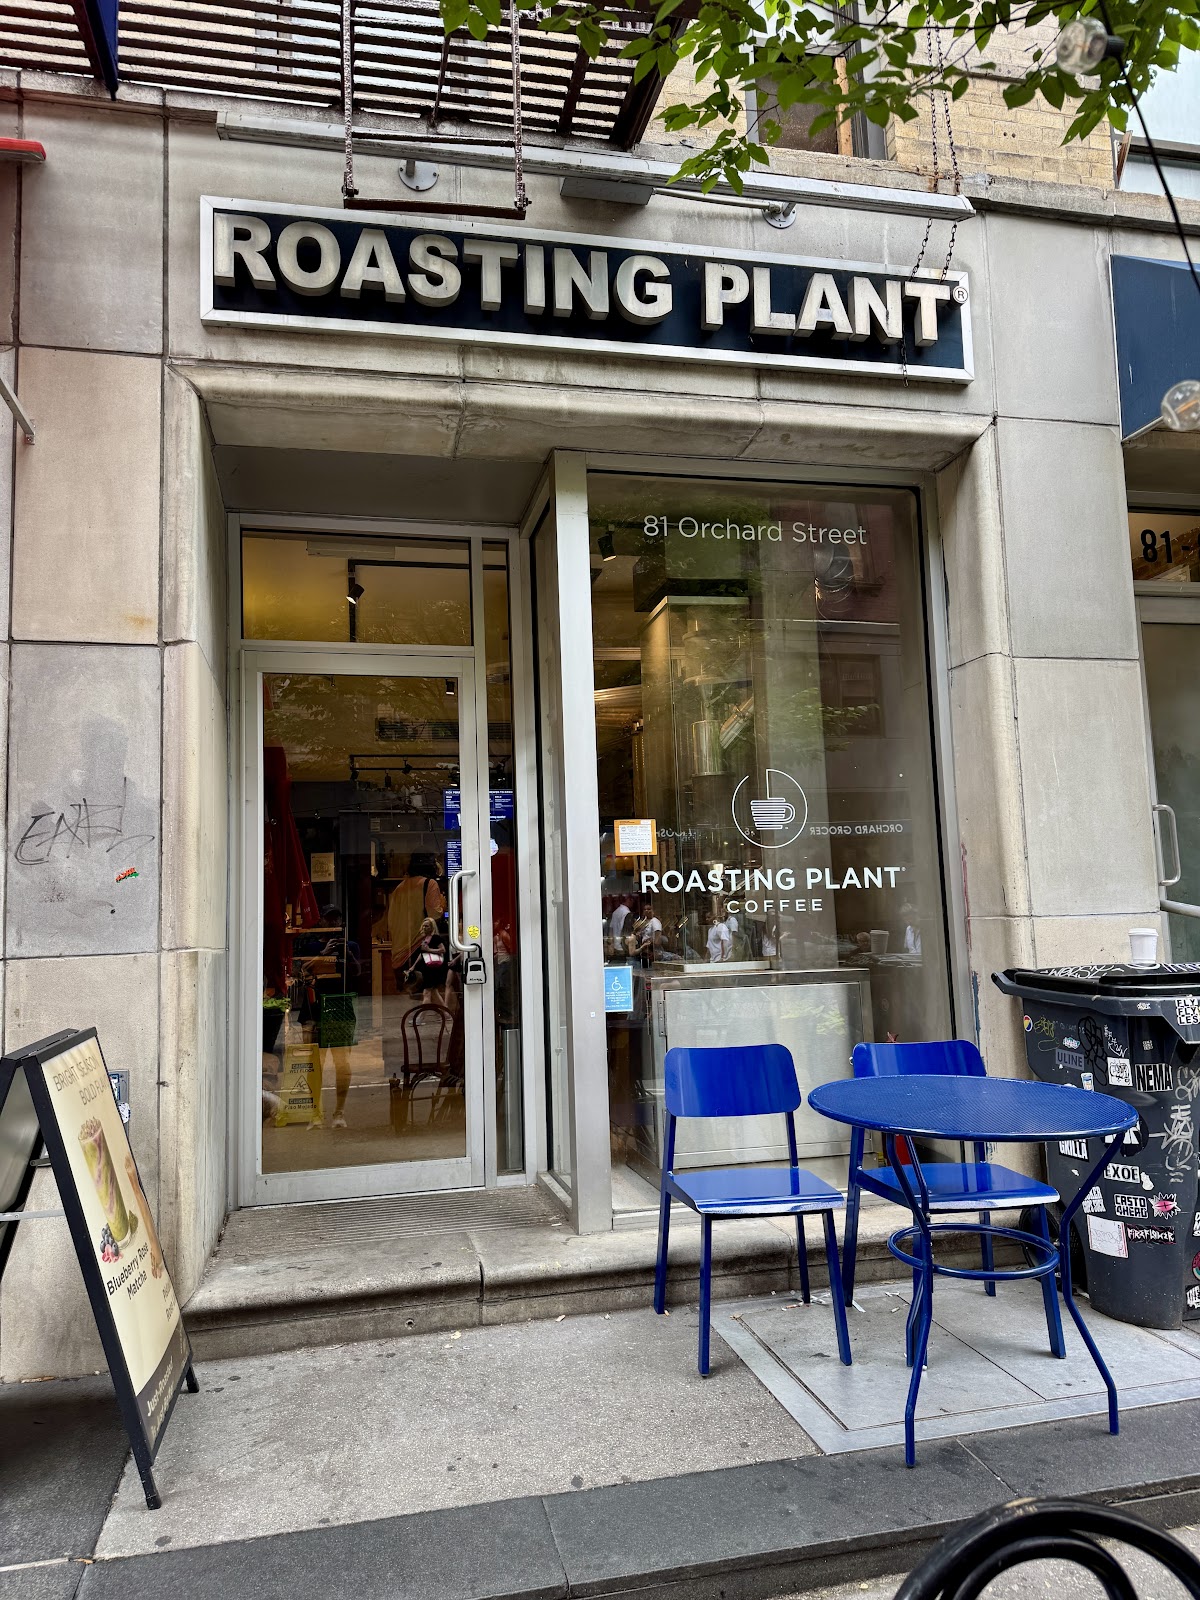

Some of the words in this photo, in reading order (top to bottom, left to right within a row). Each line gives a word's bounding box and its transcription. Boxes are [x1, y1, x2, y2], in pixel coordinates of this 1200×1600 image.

[213, 212, 673, 325] ROASTING
[643, 515, 668, 537] 81
[678, 516, 782, 542] Orchard
[792, 522, 867, 545] Street
[641, 868, 795, 894] ROASTING
[727, 898, 823, 914] COFFEE
[1176, 999, 1195, 1007] FLY
[1178, 1007, 1197, 1016] FLY
[1179, 1015, 1199, 1025] LES
[1057, 1051, 1083, 1068] ULINE
[53, 1065, 79, 1092] BRIGHT
[1136, 1064, 1172, 1091] NEMA
[79, 1083, 97, 1106] BOLD
[106, 1255, 140, 1296] Blueberry
[137, 1242, 149, 1262] Rose
[126, 1270, 148, 1300] Matcha
